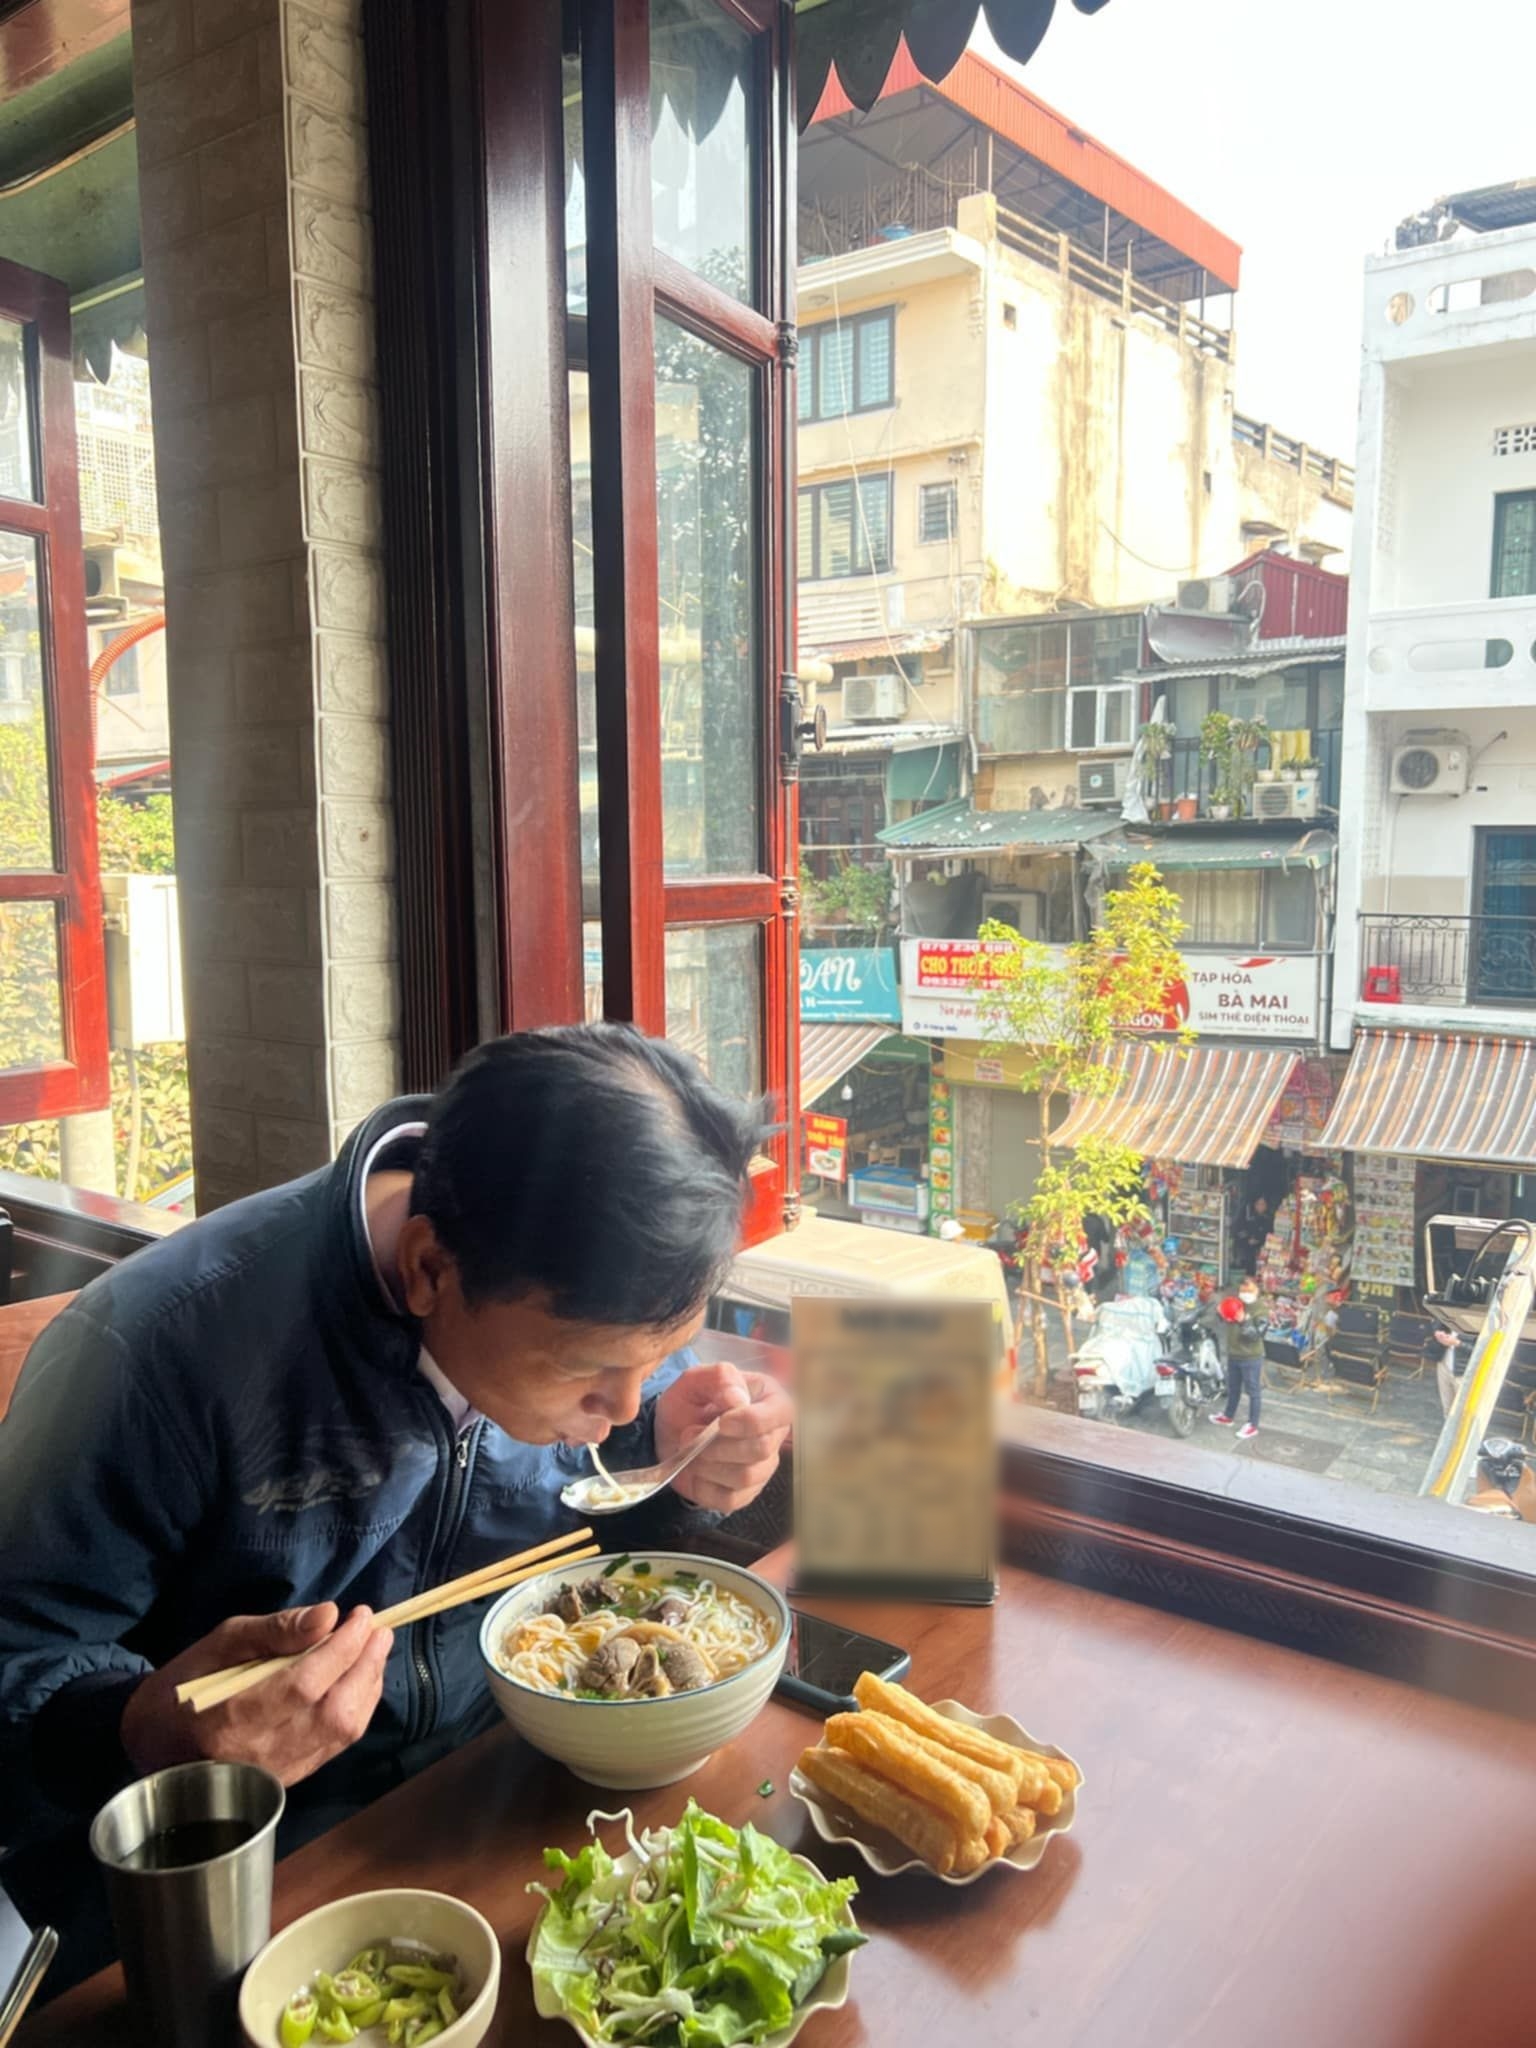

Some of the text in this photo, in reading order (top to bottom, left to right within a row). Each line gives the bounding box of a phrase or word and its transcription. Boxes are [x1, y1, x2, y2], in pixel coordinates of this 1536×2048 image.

[920, 956, 948, 975] CHO
[1218, 988, 1288, 1010] BÀ MAI
[1199, 1011, 1217, 1022] SIM
